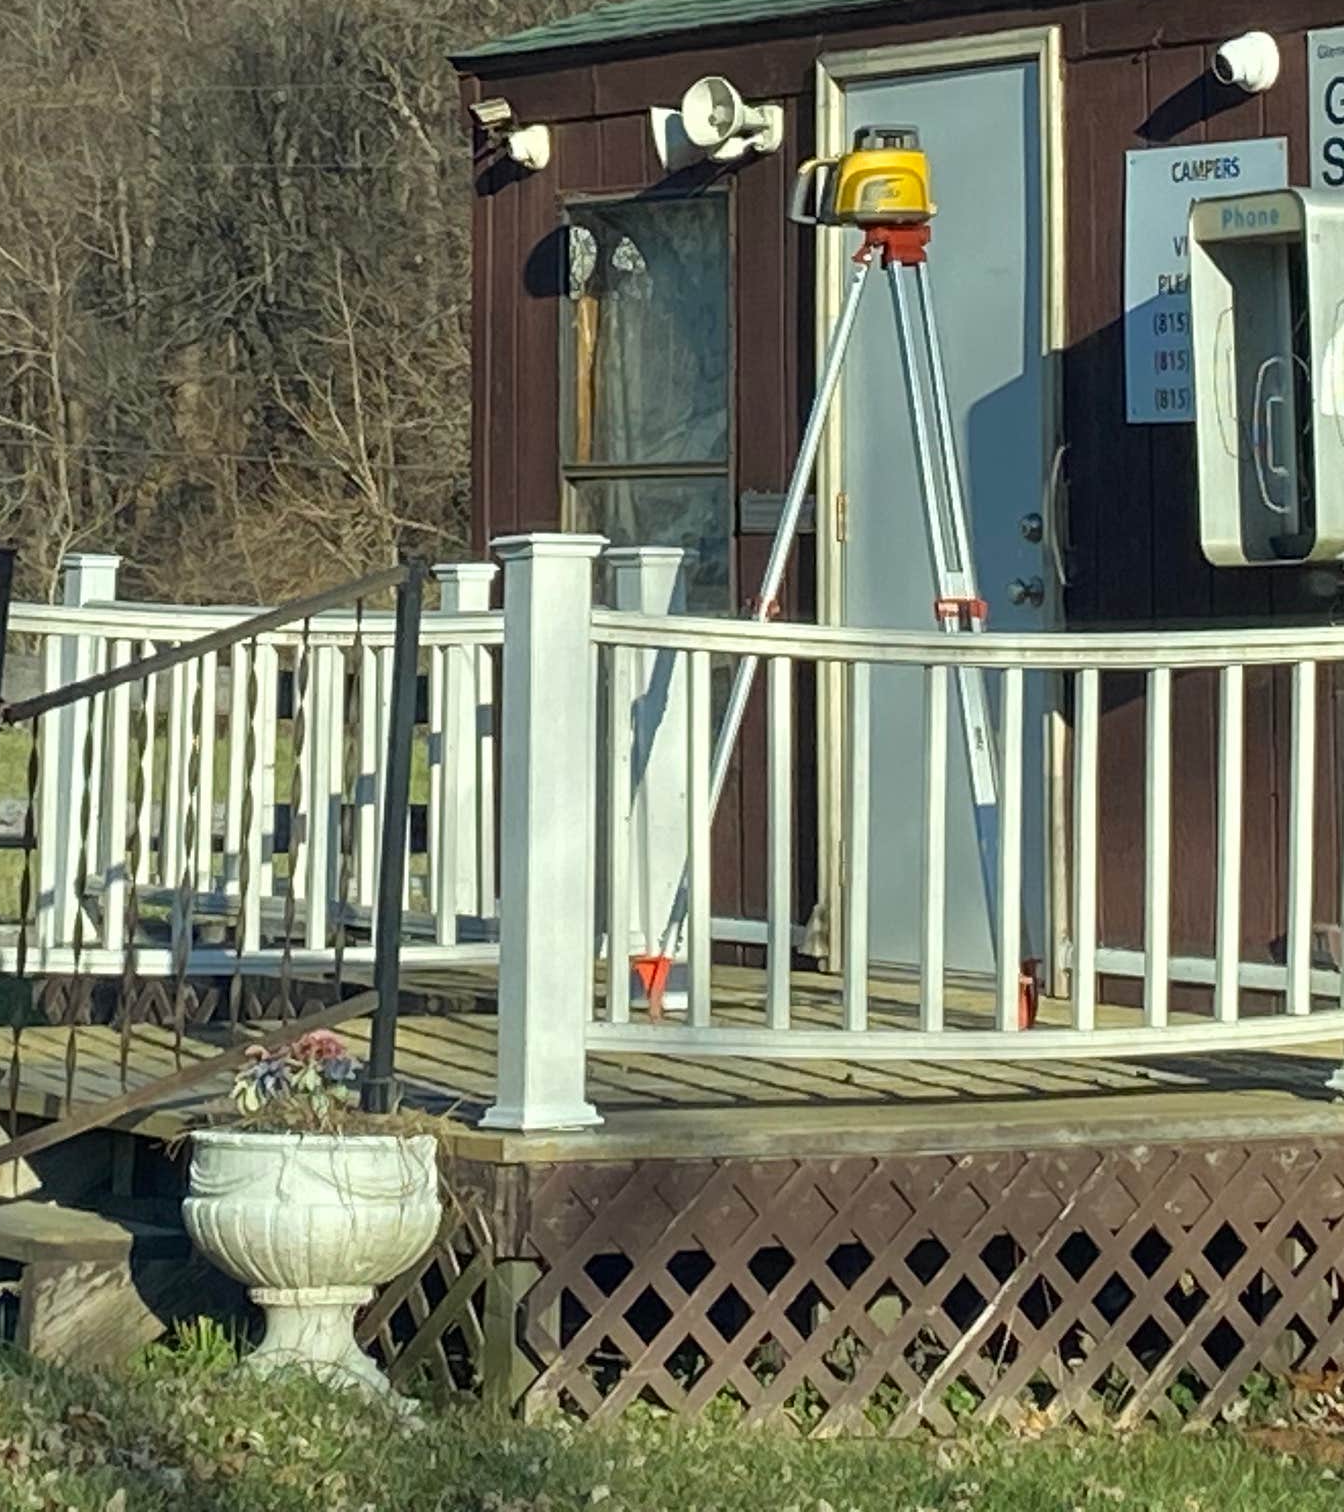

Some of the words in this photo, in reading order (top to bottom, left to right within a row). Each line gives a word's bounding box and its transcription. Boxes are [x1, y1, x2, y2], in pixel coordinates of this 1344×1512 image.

[1171, 156, 1241, 184] CAMPERS
[1221, 207, 1281, 230] Phone
[1154, 387, 1192, 411] (815)
